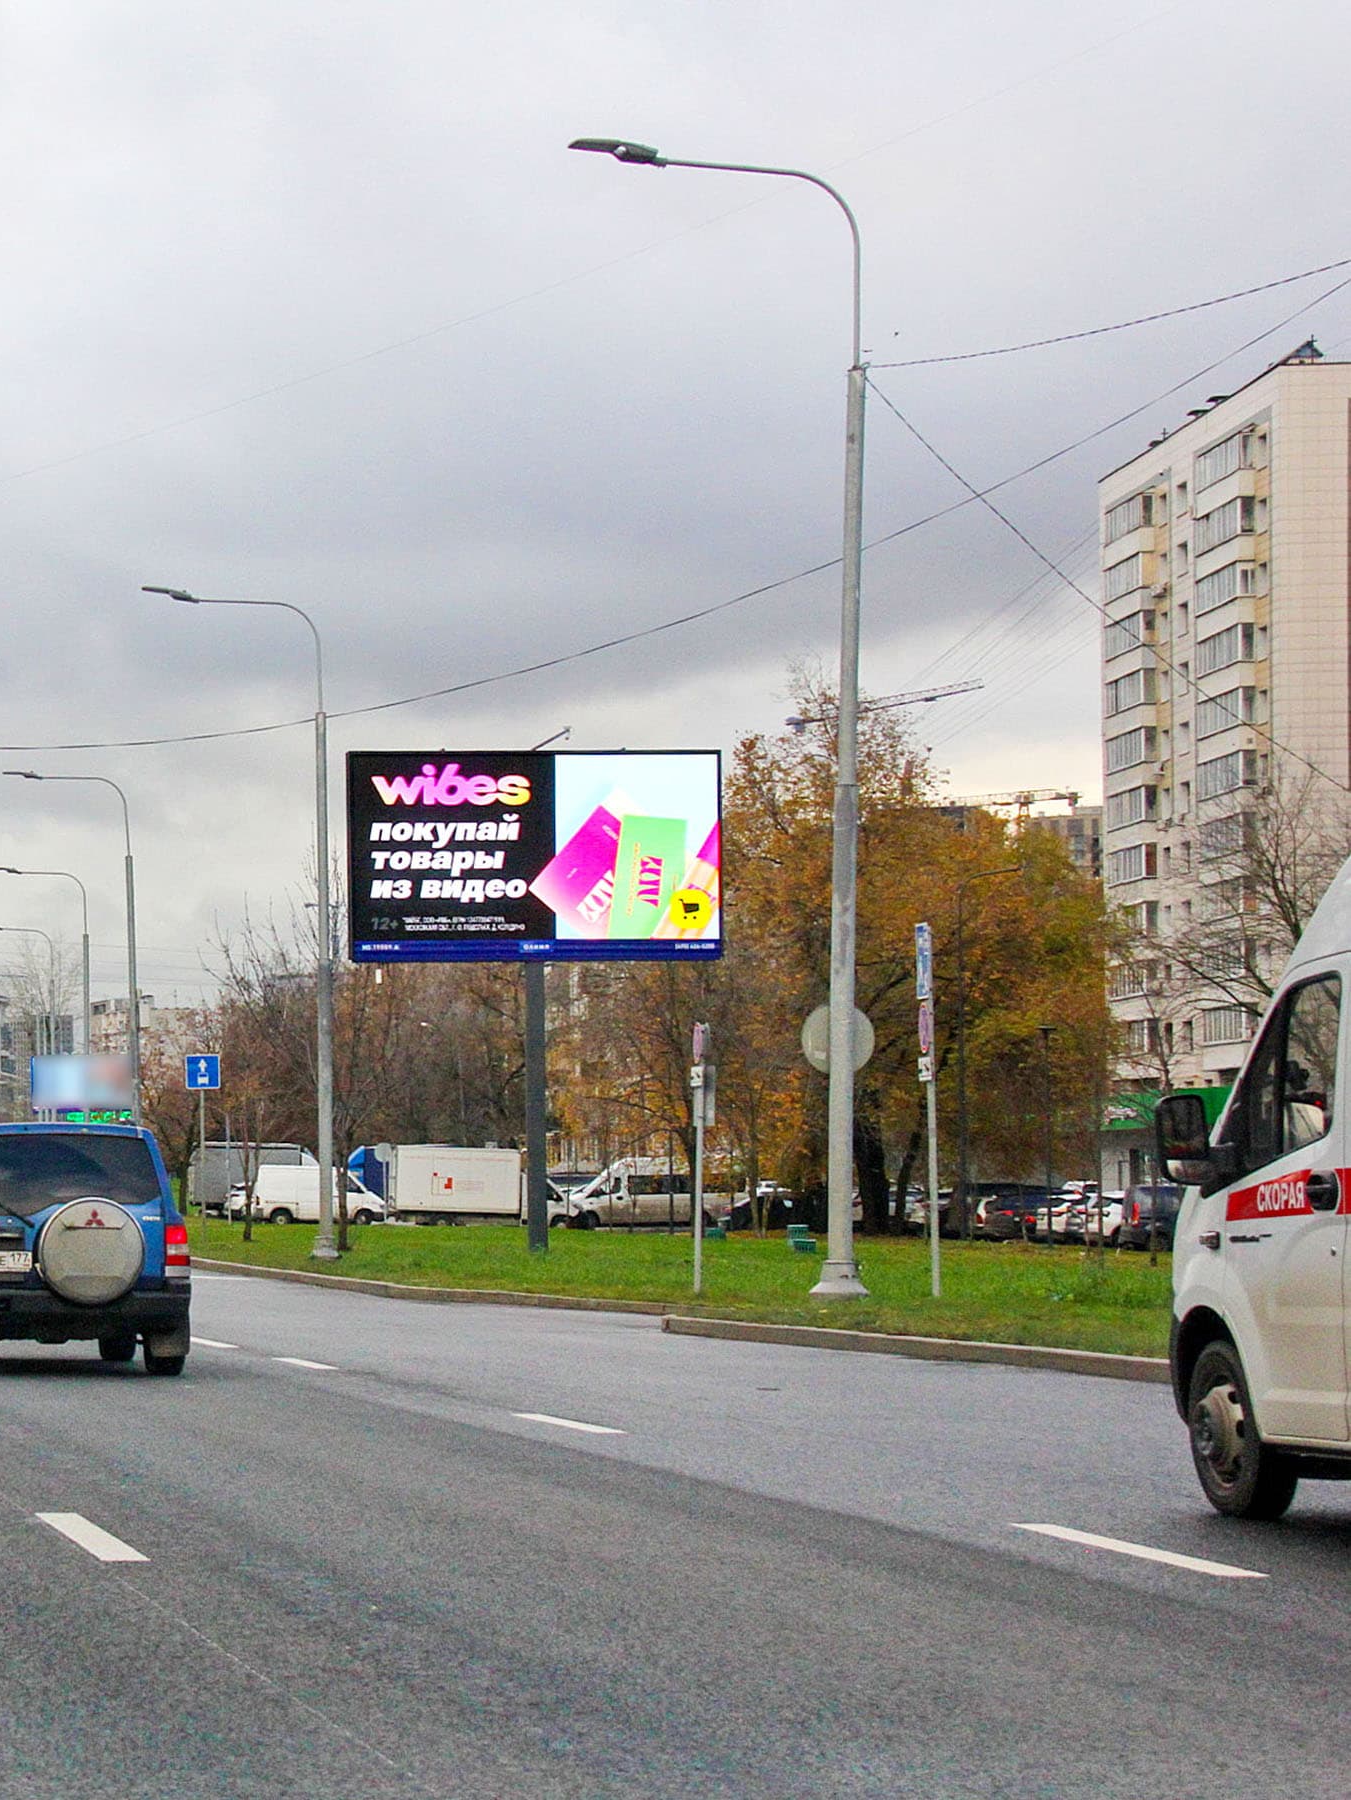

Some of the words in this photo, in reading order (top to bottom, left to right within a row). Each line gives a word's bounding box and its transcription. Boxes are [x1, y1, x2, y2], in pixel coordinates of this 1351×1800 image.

[369, 813, 521, 849] покупай
[371, 851, 505, 877] товары
[370, 879, 413, 899] из
[420, 878, 527, 903] видео
[371, 917, 399, 930] 12+
[1257, 1181, 1305, 1212] СКОРАЯ
